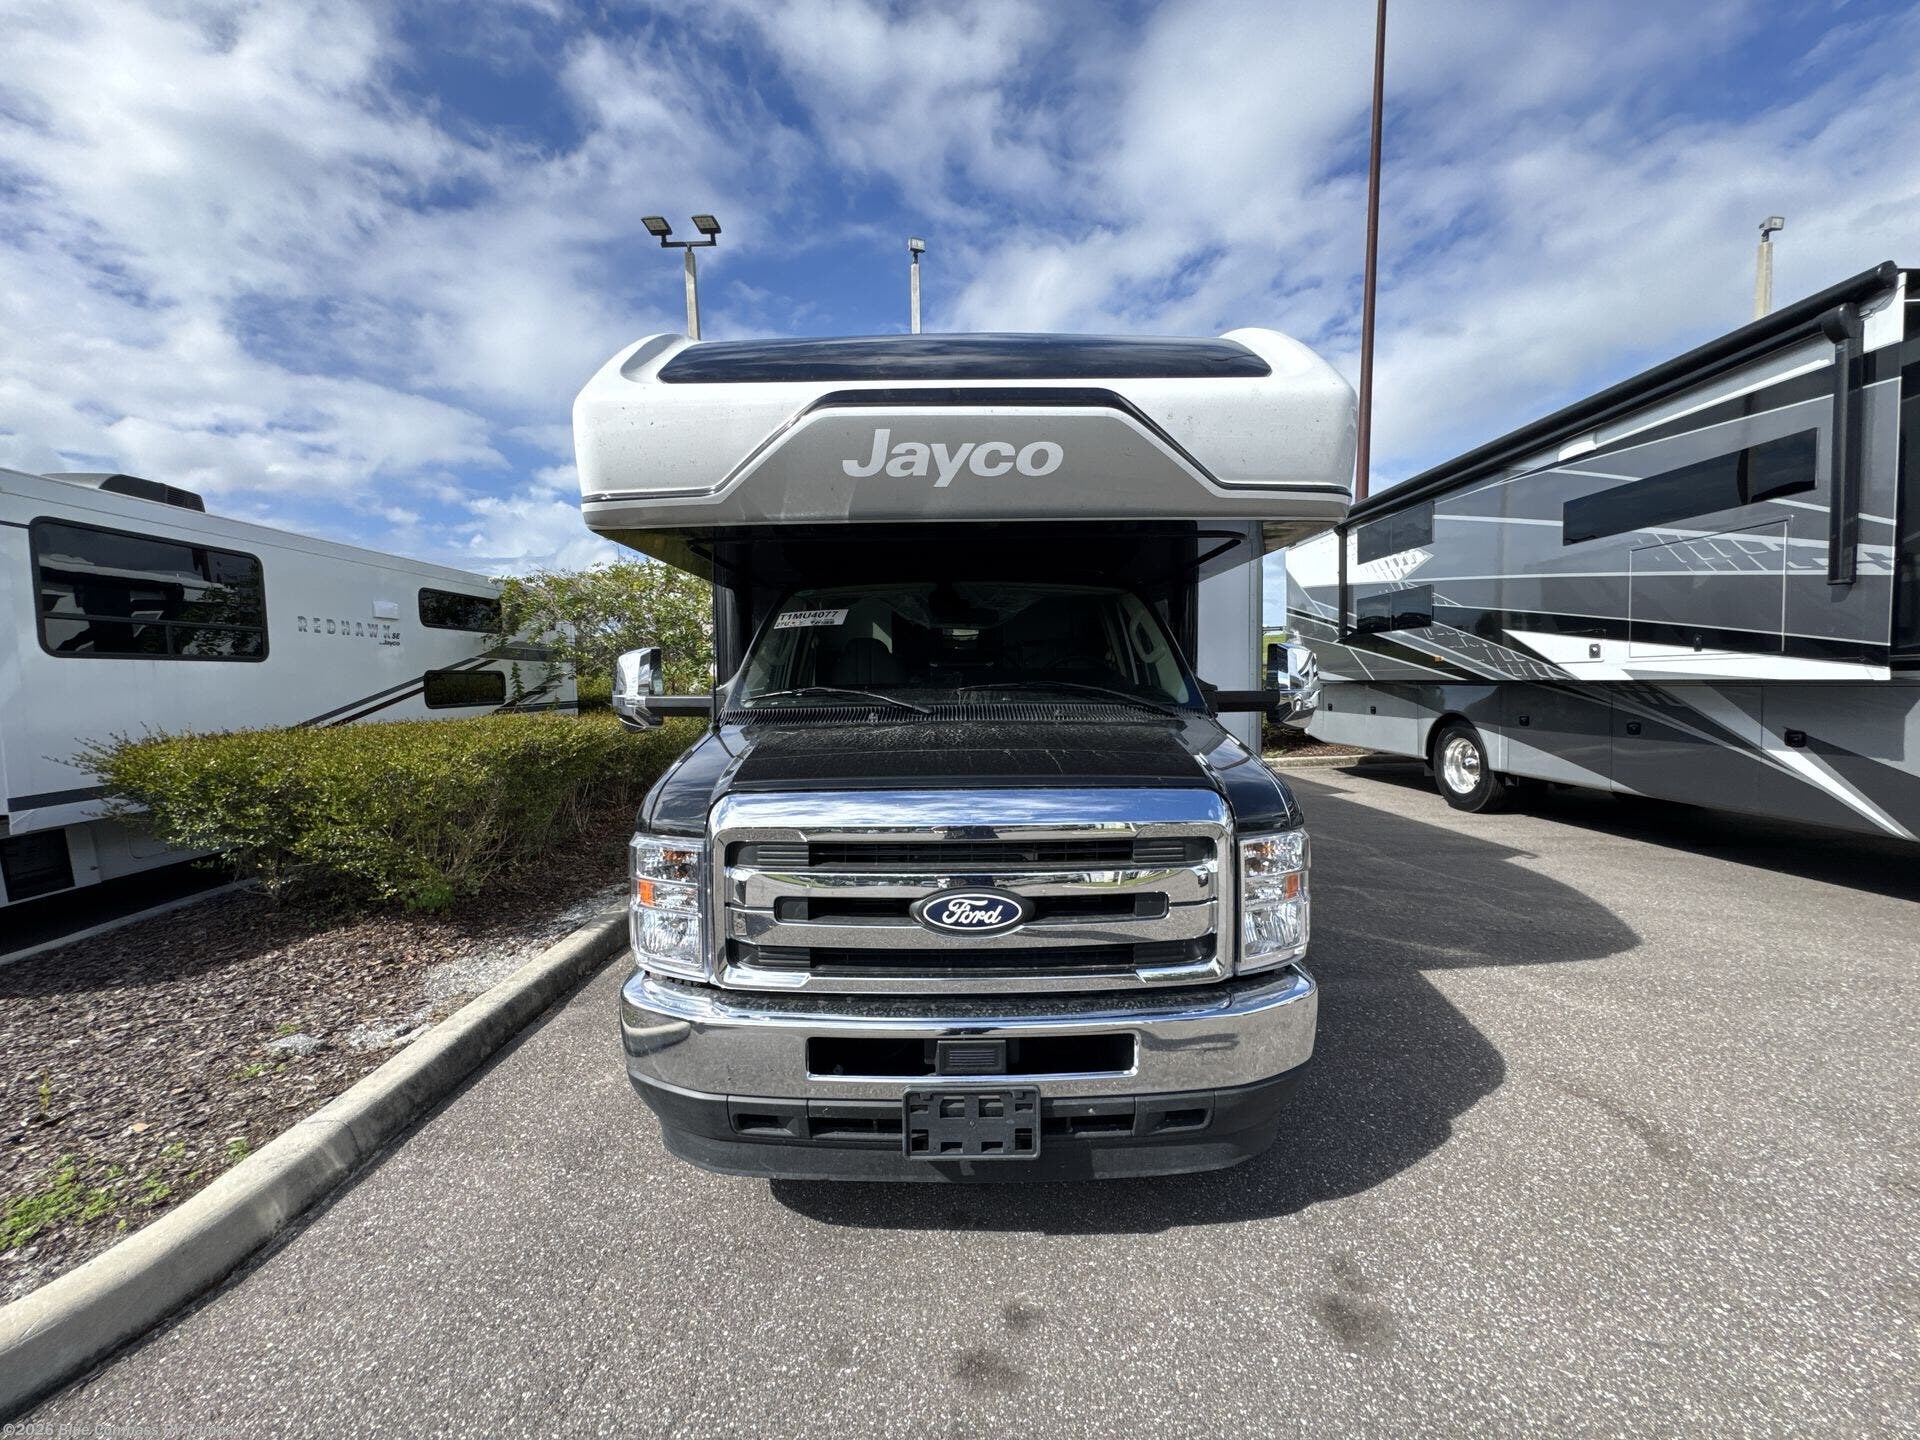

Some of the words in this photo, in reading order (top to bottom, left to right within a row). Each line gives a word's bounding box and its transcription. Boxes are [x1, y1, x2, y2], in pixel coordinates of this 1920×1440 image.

[842, 428, 1064, 488] Jayco
[297, 615, 391, 640] REDHAWK
[942, 898, 1004, 924] Ford
